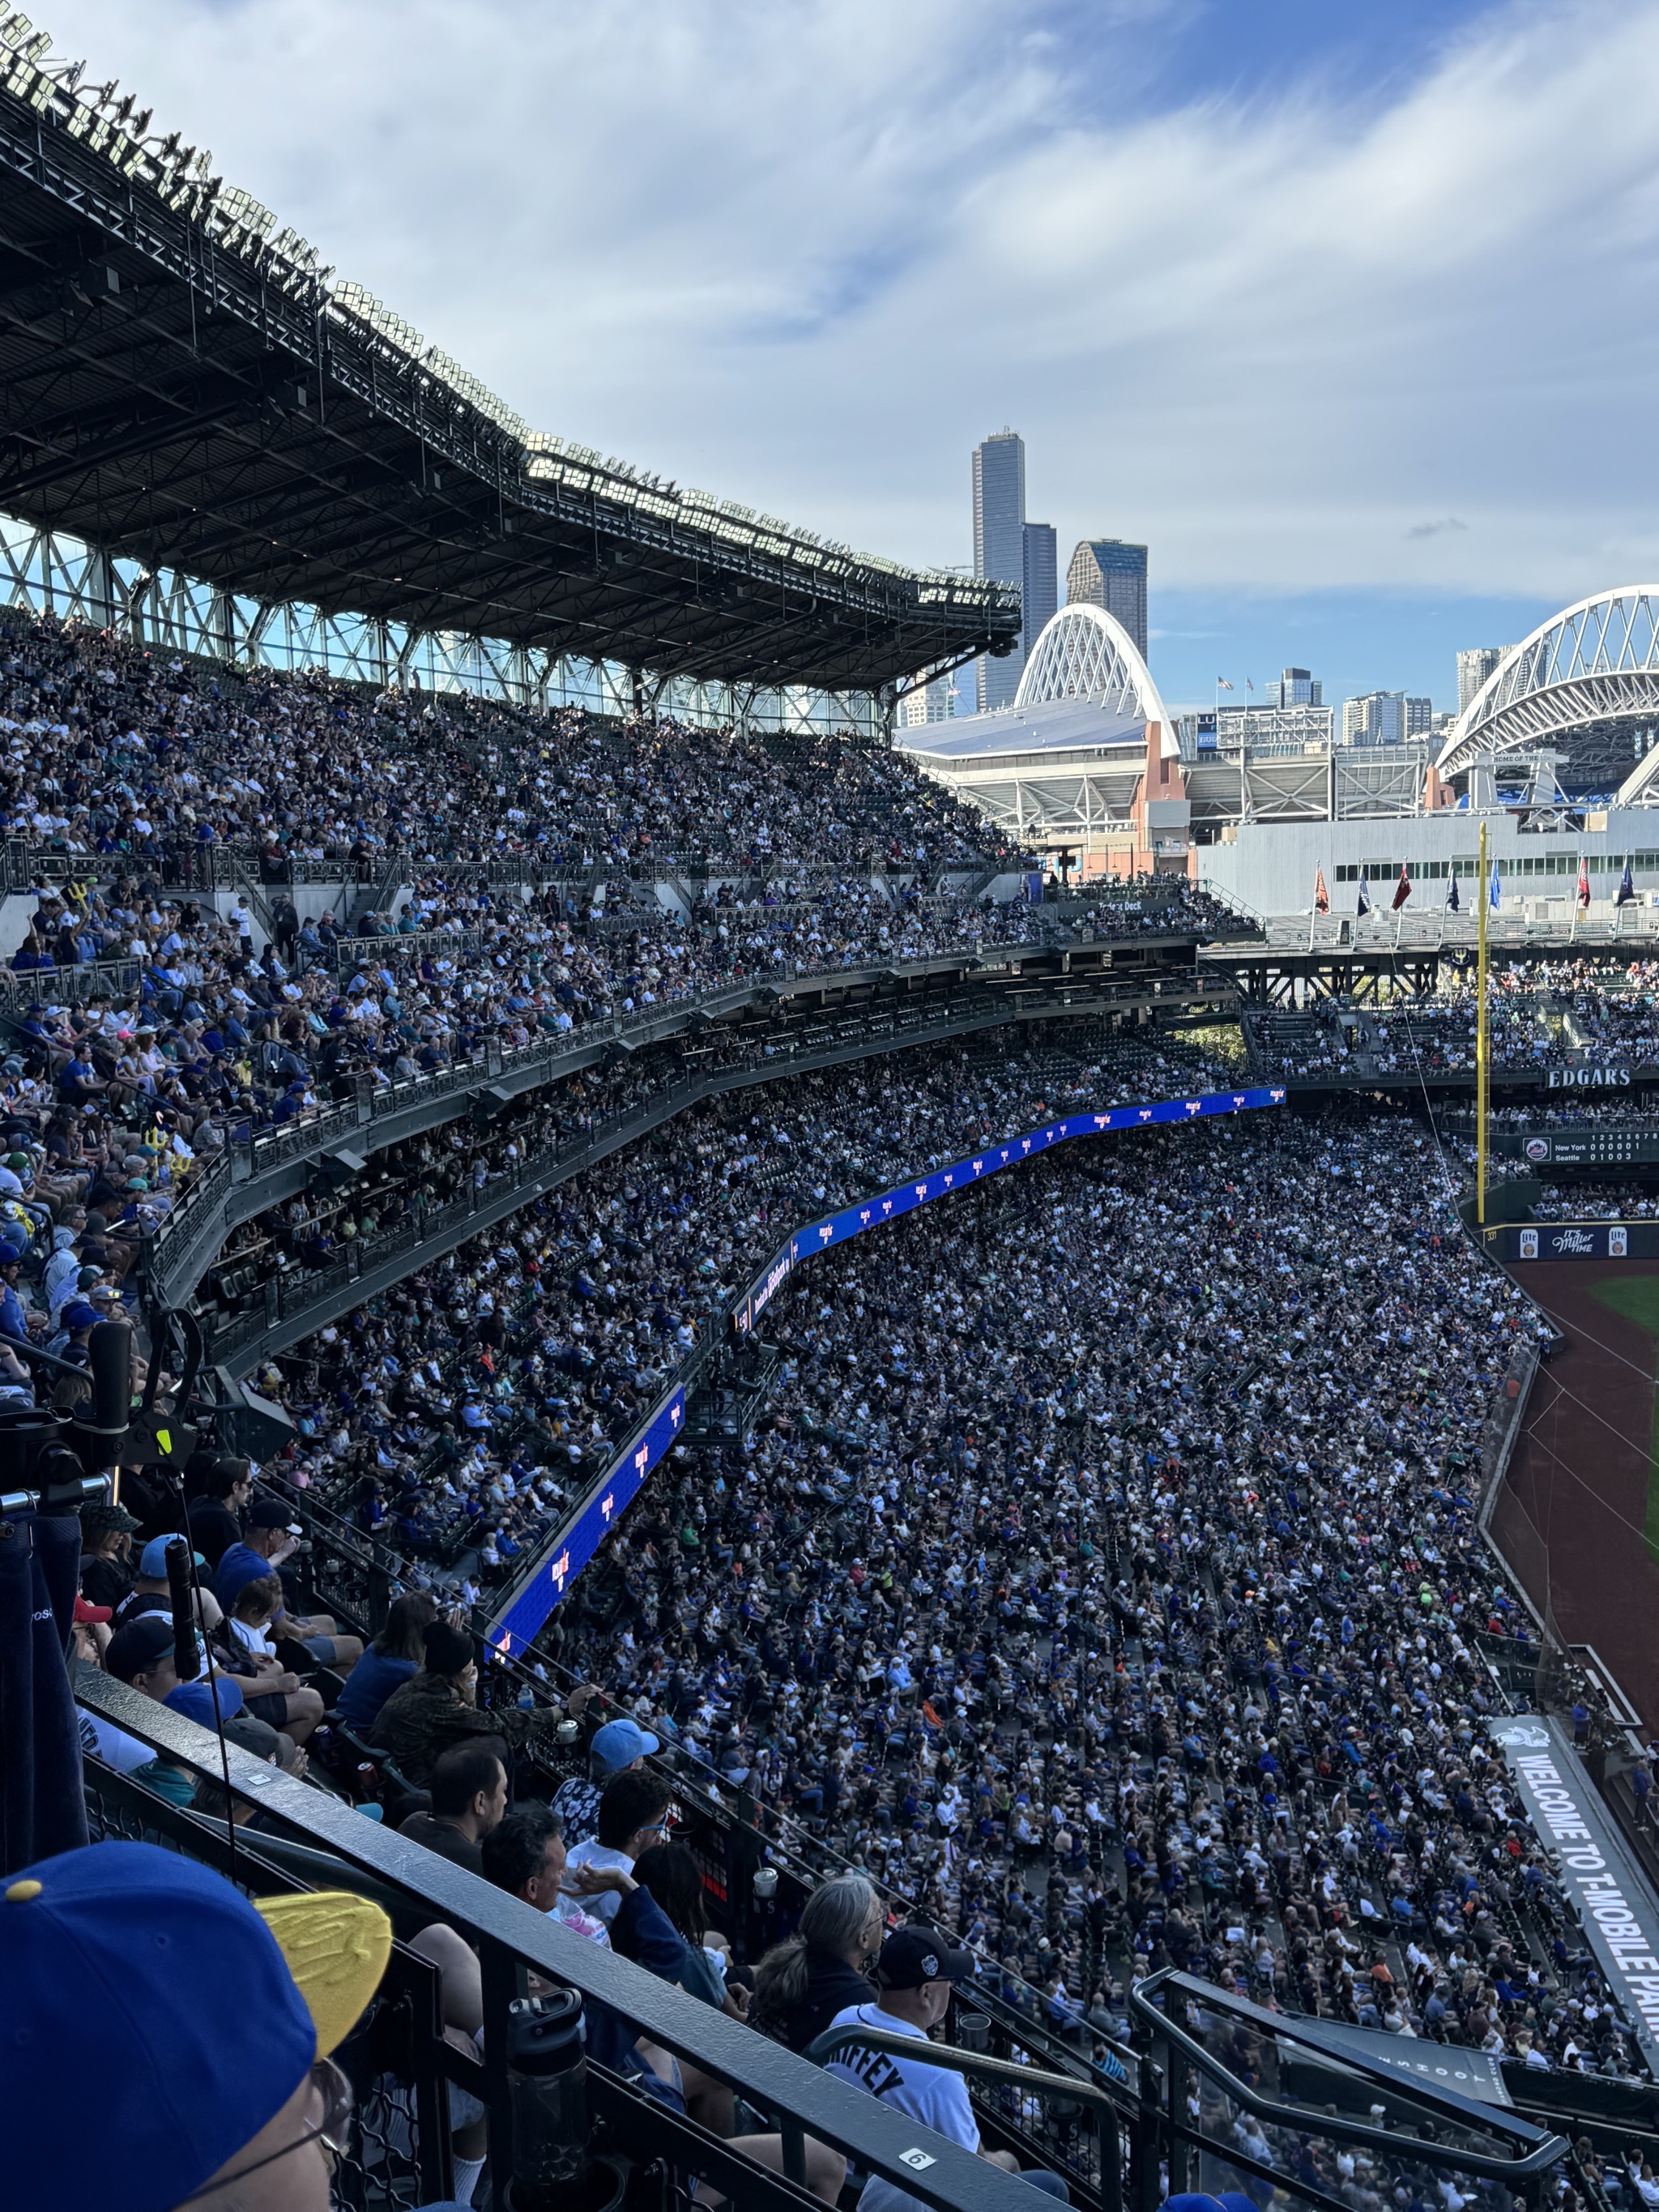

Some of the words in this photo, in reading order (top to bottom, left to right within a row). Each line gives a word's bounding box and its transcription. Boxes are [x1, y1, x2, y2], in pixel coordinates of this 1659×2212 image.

[1124, 900, 1142, 911] Deck
[1548, 1068, 1631, 1088] EDGAR'S
[1487, 1230, 1497, 1241] 331
[1522, 1233, 1537, 1243] Lite
[1563, 1229, 1581, 1239] IT'S
[1610, 1230, 1626, 1241] Lite
[1552, 1233, 1594, 1253] Miller
[1572, 1244, 1593, 1253] TIME
[1516, 1753, 1592, 1840] WELCOME
[1561, 1843, 1606, 1870] TO
[1576, 1873, 1659, 1971] T-MOBILE
[908, 2154, 927, 2164] 6
